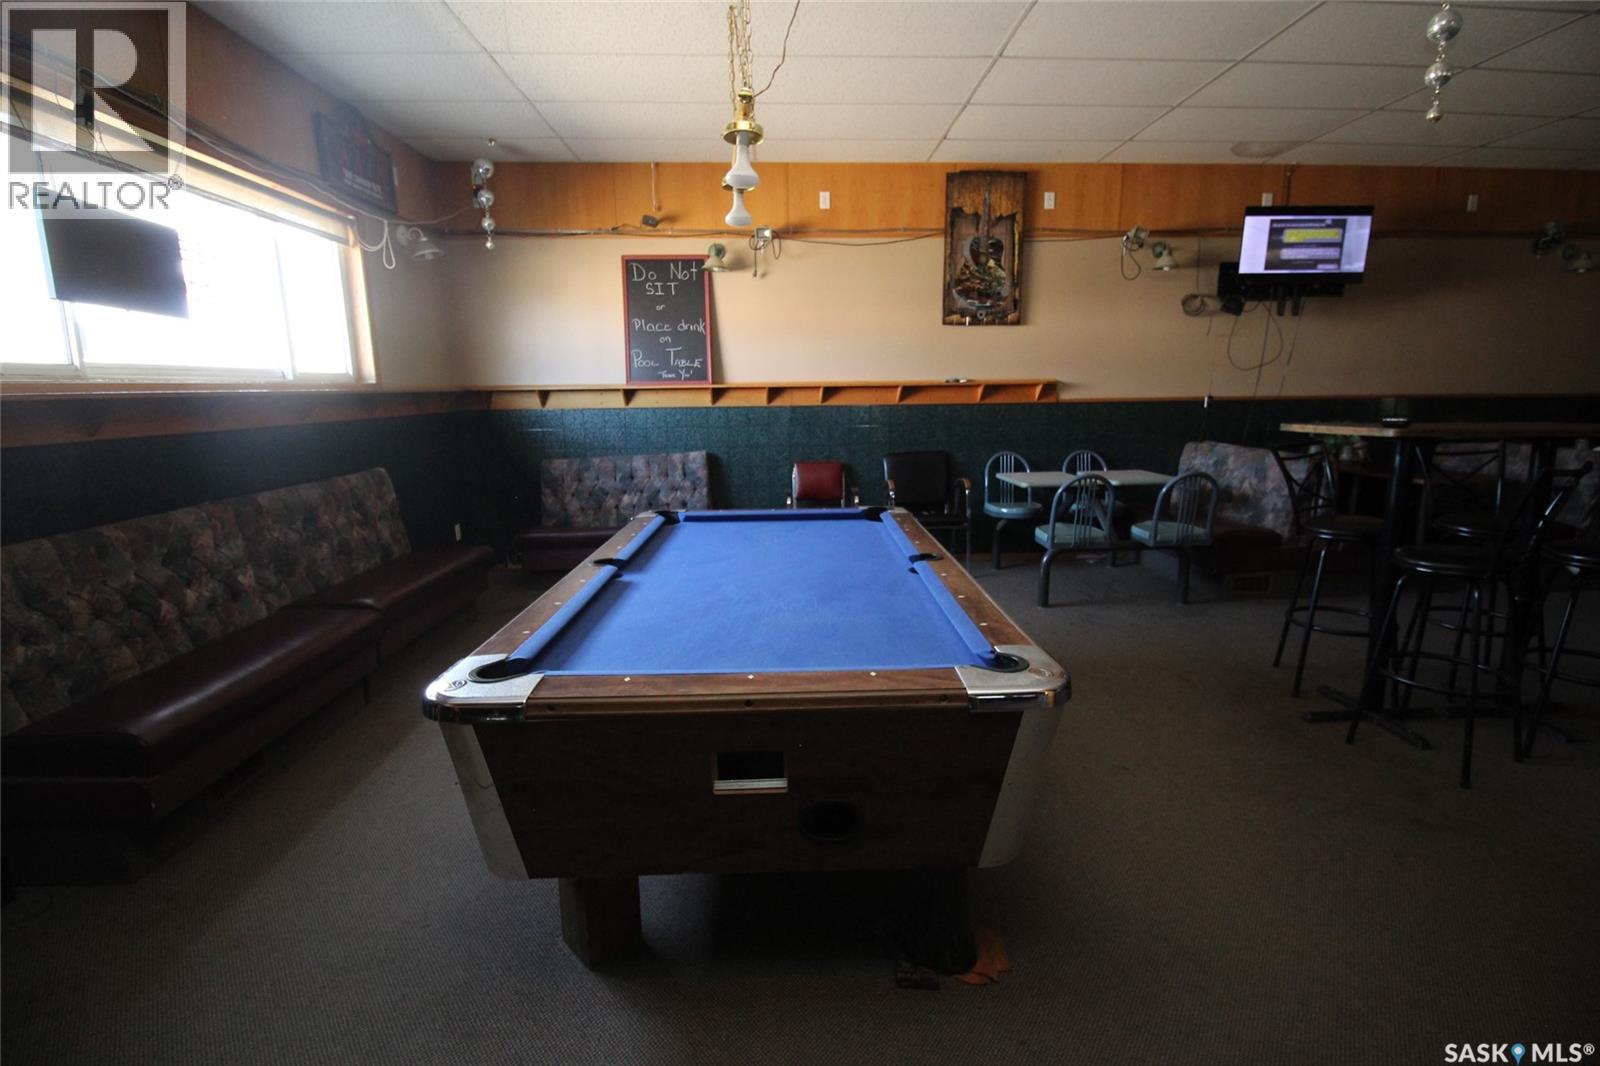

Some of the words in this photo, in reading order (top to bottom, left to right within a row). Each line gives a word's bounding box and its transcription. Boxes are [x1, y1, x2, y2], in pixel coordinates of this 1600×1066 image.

[629, 262, 657, 281] Do
[669, 261, 698, 281] Not
[645, 282, 679, 295] SIT
[631, 318, 672, 331] Place
[676, 318, 706, 335] drink
[659, 335, 672, 343] on
